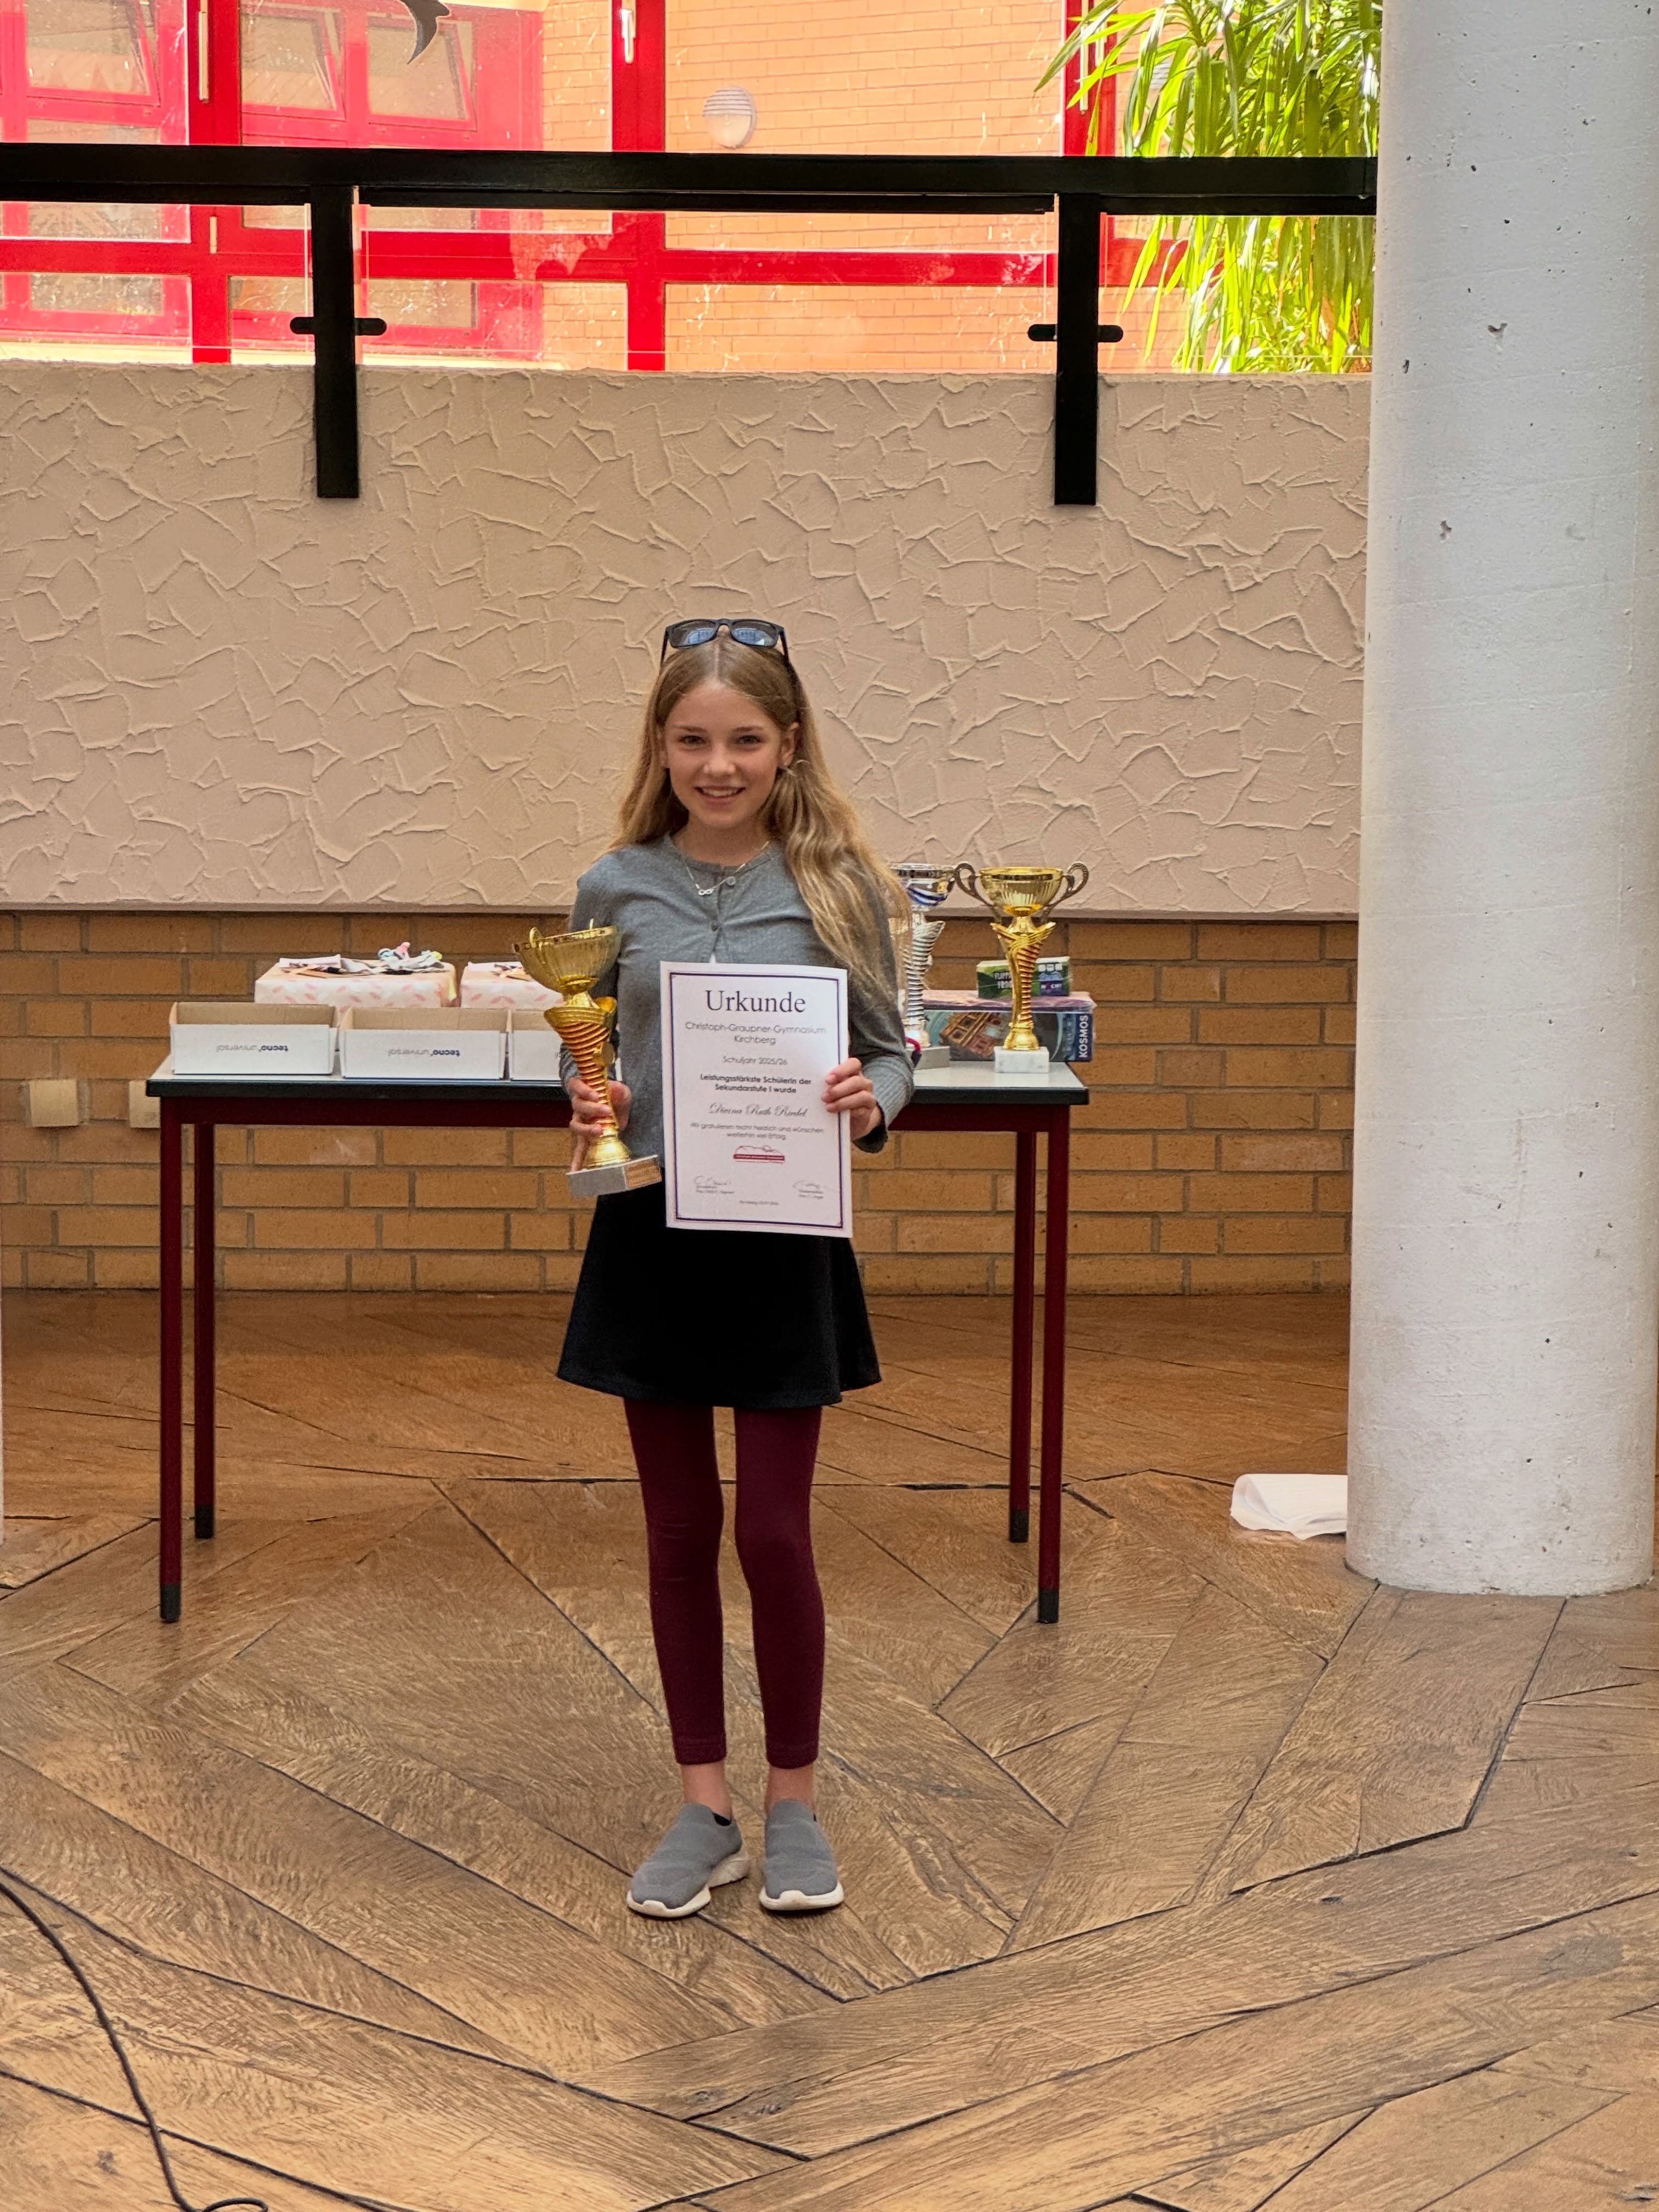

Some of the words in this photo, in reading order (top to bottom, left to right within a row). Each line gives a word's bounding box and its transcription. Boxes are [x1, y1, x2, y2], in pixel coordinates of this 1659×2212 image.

[705, 990, 806, 1013] Urkunde
[685, 1022, 826, 1034] Christoph-Graupner-Gymnasium
[734, 1035, 776, 1045] Kirchberg
[1079, 1015, 1088, 1058] KOSMOS
[723, 1056, 757, 1065] Schuljahr
[763, 1076, 797, 1084] Schülerin
